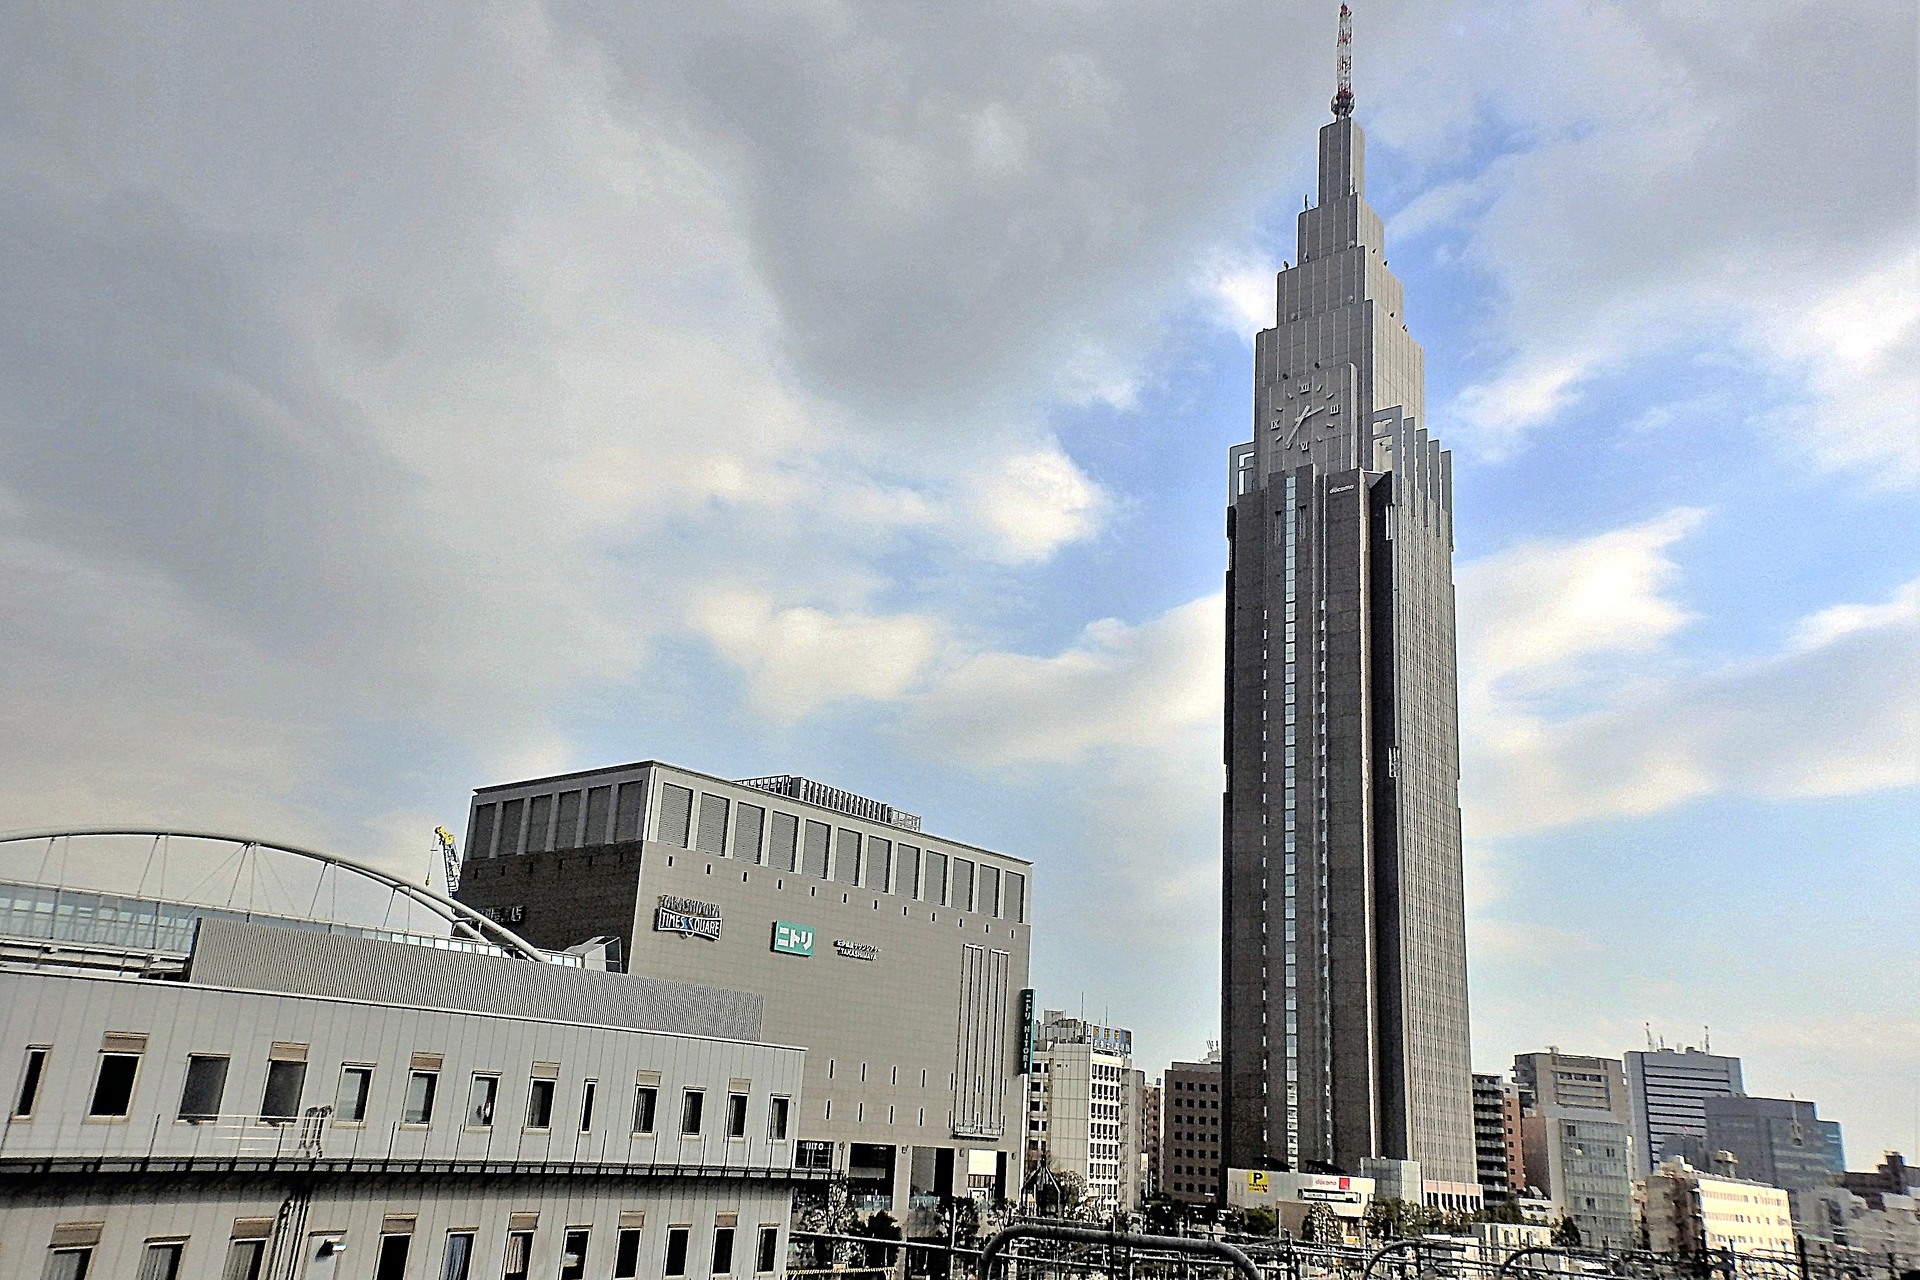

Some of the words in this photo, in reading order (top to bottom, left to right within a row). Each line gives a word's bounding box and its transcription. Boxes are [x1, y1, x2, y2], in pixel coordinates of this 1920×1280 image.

[1329, 484, 1355, 494] docomo
[662, 894, 721, 918] TAKASHIMAYA
[661, 912, 685, 929] TIMES
[685, 917, 720, 938] SQUARE
[777, 926, 813, 951] ニトリ
[1022, 1025, 1031, 1069] NITORI
[1253, 1172, 1264, 1184] P
